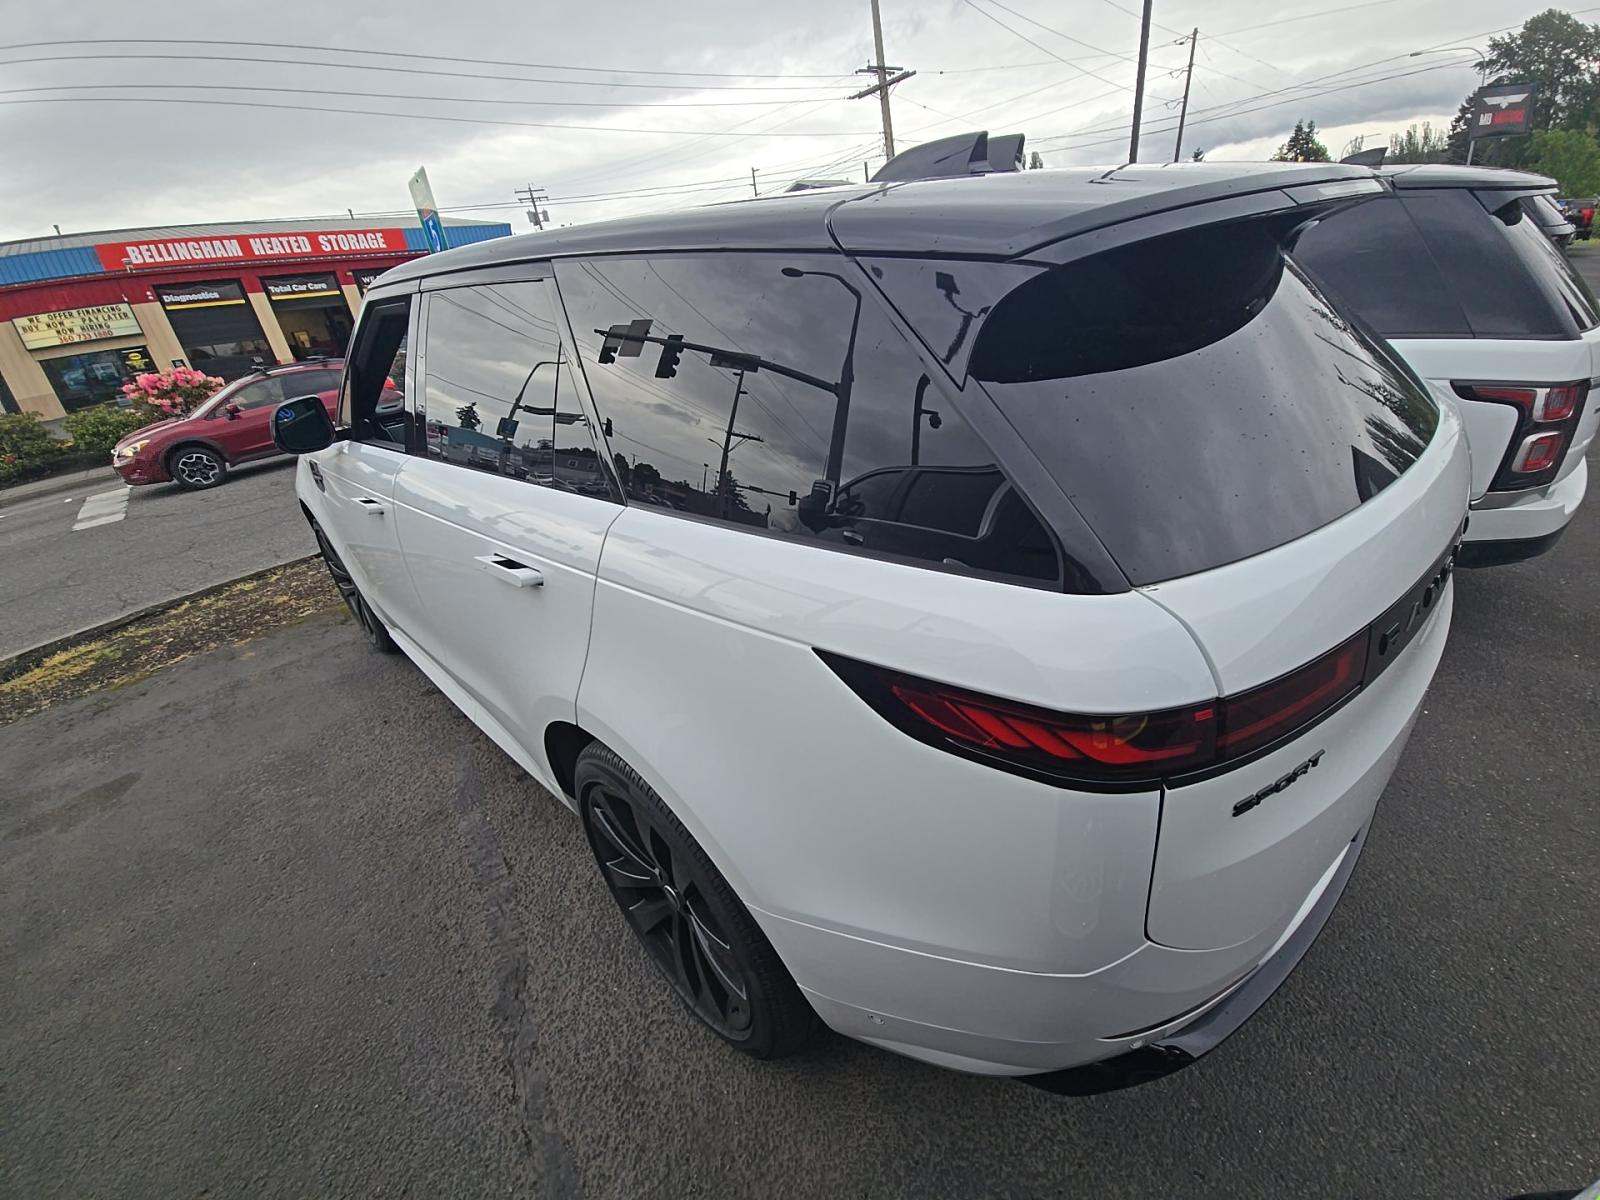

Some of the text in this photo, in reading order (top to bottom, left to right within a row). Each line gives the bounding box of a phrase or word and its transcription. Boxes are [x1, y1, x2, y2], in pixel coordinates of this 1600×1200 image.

[126, 232, 386, 264] BELLINGHAM HEATED STORAGE
[268, 282, 327, 294] Total Car Care
[162, 290, 220, 303] Diagnostics
[21, 324, 39, 333] BUY
[45, 320, 65, 329] NOW
[81, 315, 101, 324] PAY
[102, 312, 130, 322] LATER
[27, 305, 122, 324] WE OFFER FINANCING
[55, 322, 111, 336] NOW HIRING
